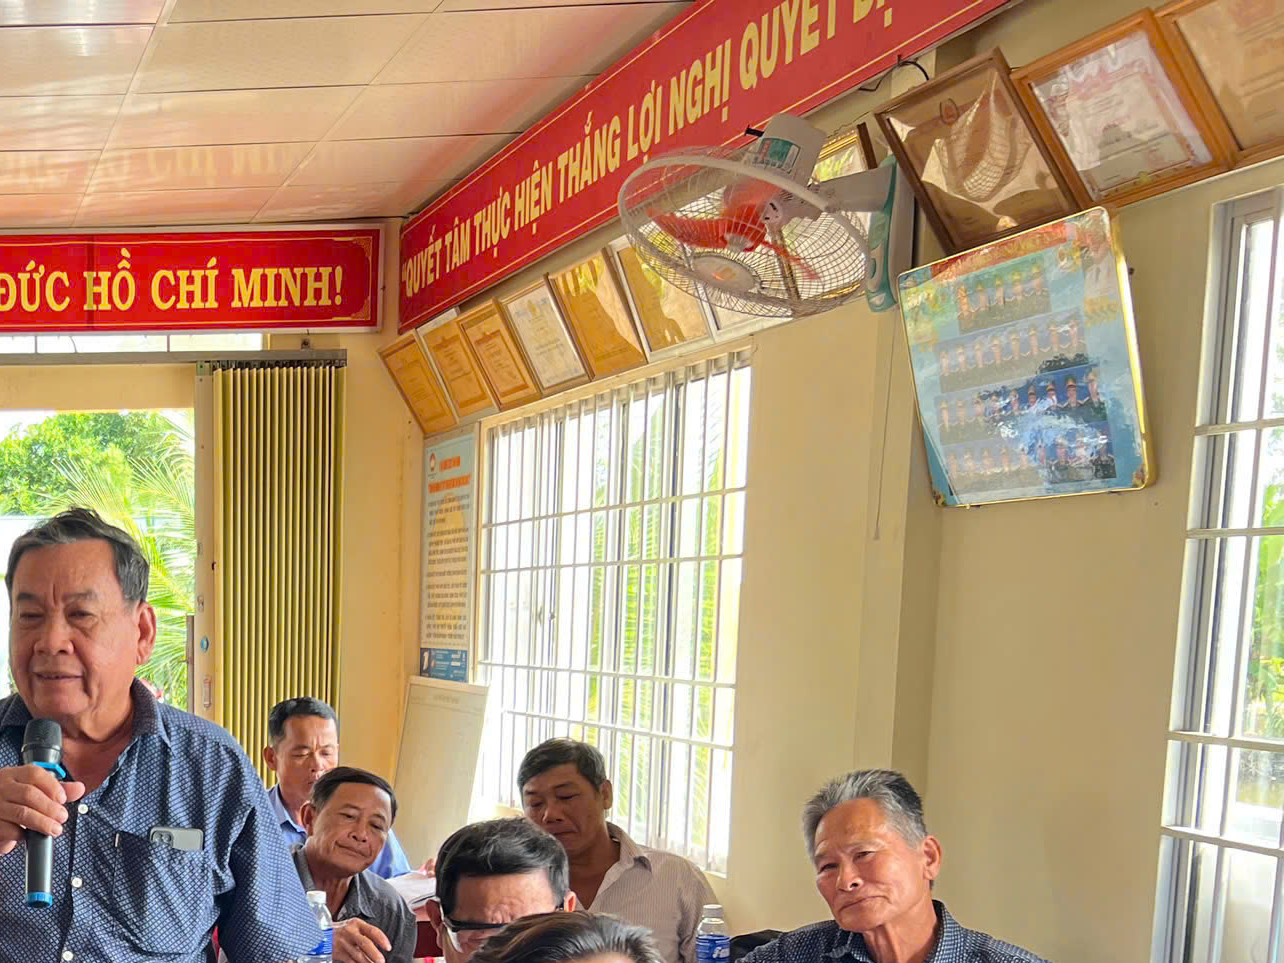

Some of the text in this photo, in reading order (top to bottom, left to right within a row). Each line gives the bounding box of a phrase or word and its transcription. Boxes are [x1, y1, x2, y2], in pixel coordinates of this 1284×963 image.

[444, 216, 471, 273] TÂM
[473, 186, 511, 257] THỰC
[513, 159, 553, 235] HIỆN
[557, 110, 621, 204] THẮNG
[626, 79, 663, 163] LỢI
[668, 38, 732, 122] NGHỊ
[83, 247, 136, 311] HỒ
[152, 257, 219, 310] CHÍ
[231, 266, 343, 308] MINH!
